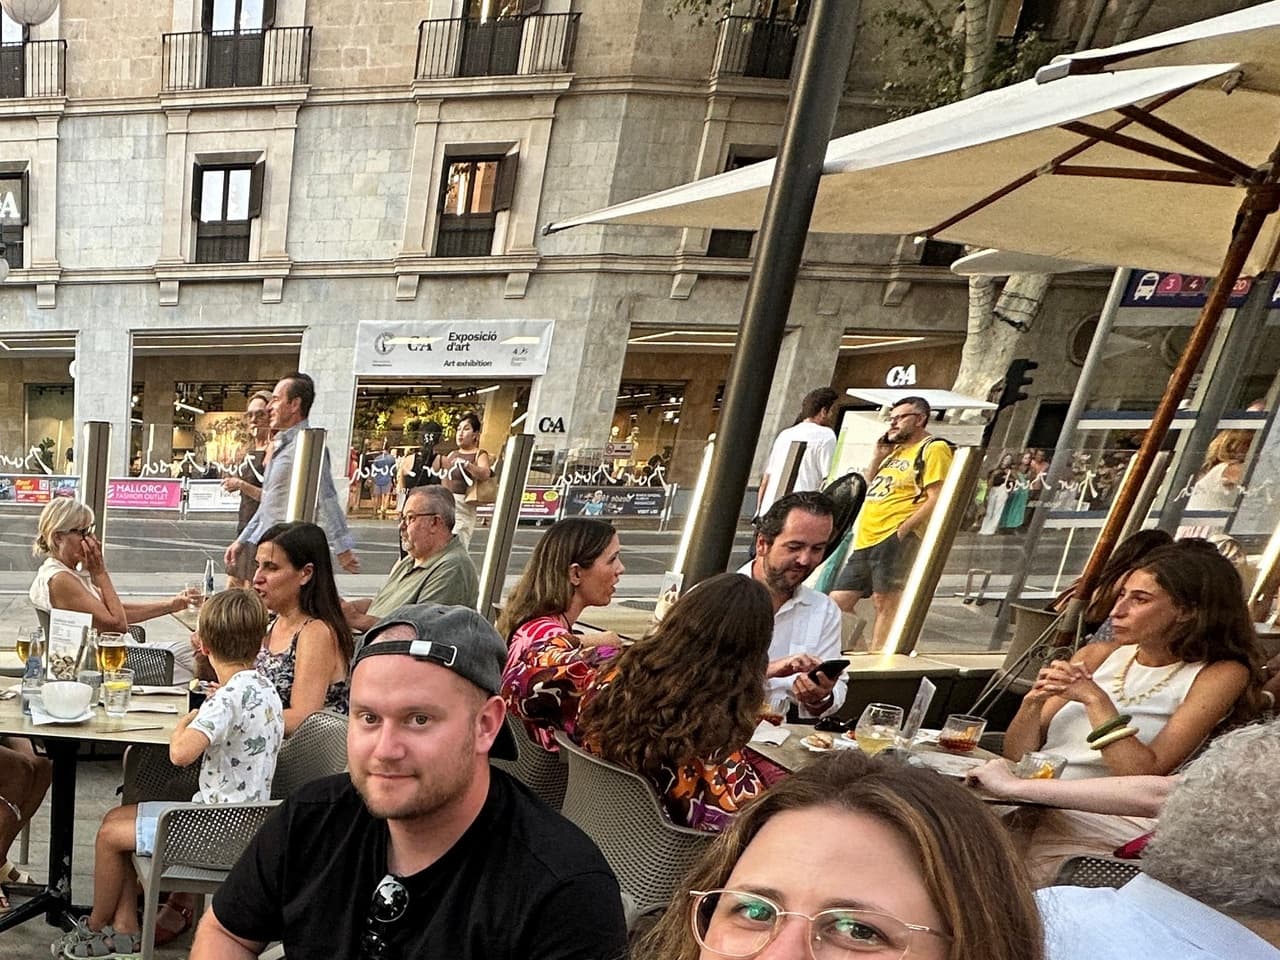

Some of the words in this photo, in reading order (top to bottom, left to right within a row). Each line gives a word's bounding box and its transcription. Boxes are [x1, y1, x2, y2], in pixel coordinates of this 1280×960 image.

[1165, 279, 1176, 290] 3
[1189, 279, 1199, 290] 4
[448, 331, 497, 343] Exposició
[446, 342, 471, 352] d'art
[116, 484, 168, 494] MALLORCA
[867, 476, 893, 497] 23
[144, 493, 168, 501] OUTLET
